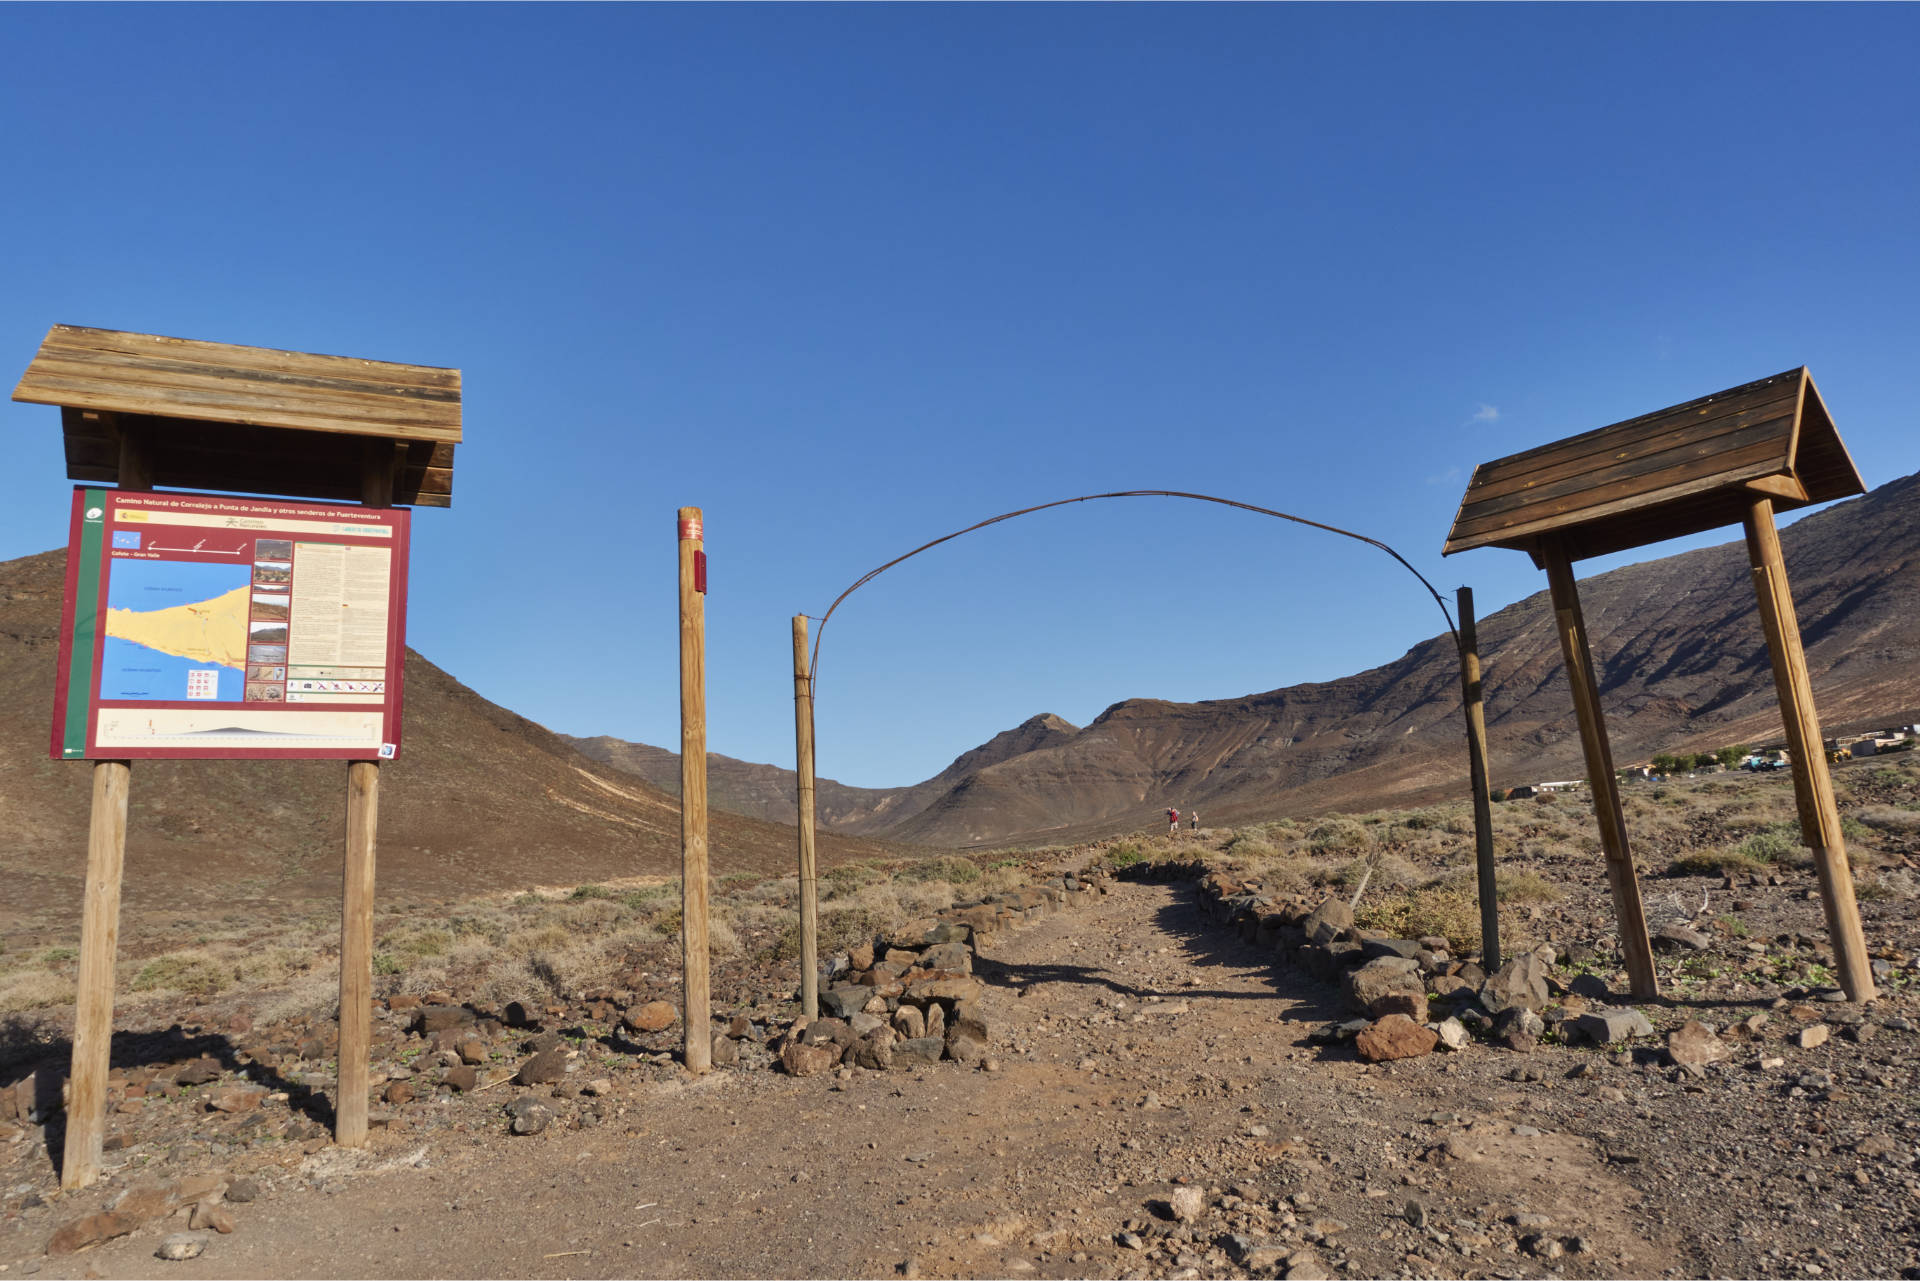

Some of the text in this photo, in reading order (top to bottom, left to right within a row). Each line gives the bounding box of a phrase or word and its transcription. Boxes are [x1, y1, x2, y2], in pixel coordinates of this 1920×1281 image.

[115, 497, 142, 505] Camino
[180, 501, 212, 509] Corralejo
[219, 503, 239, 511] Punta
[337, 511, 381, 520] Fuerteventura
